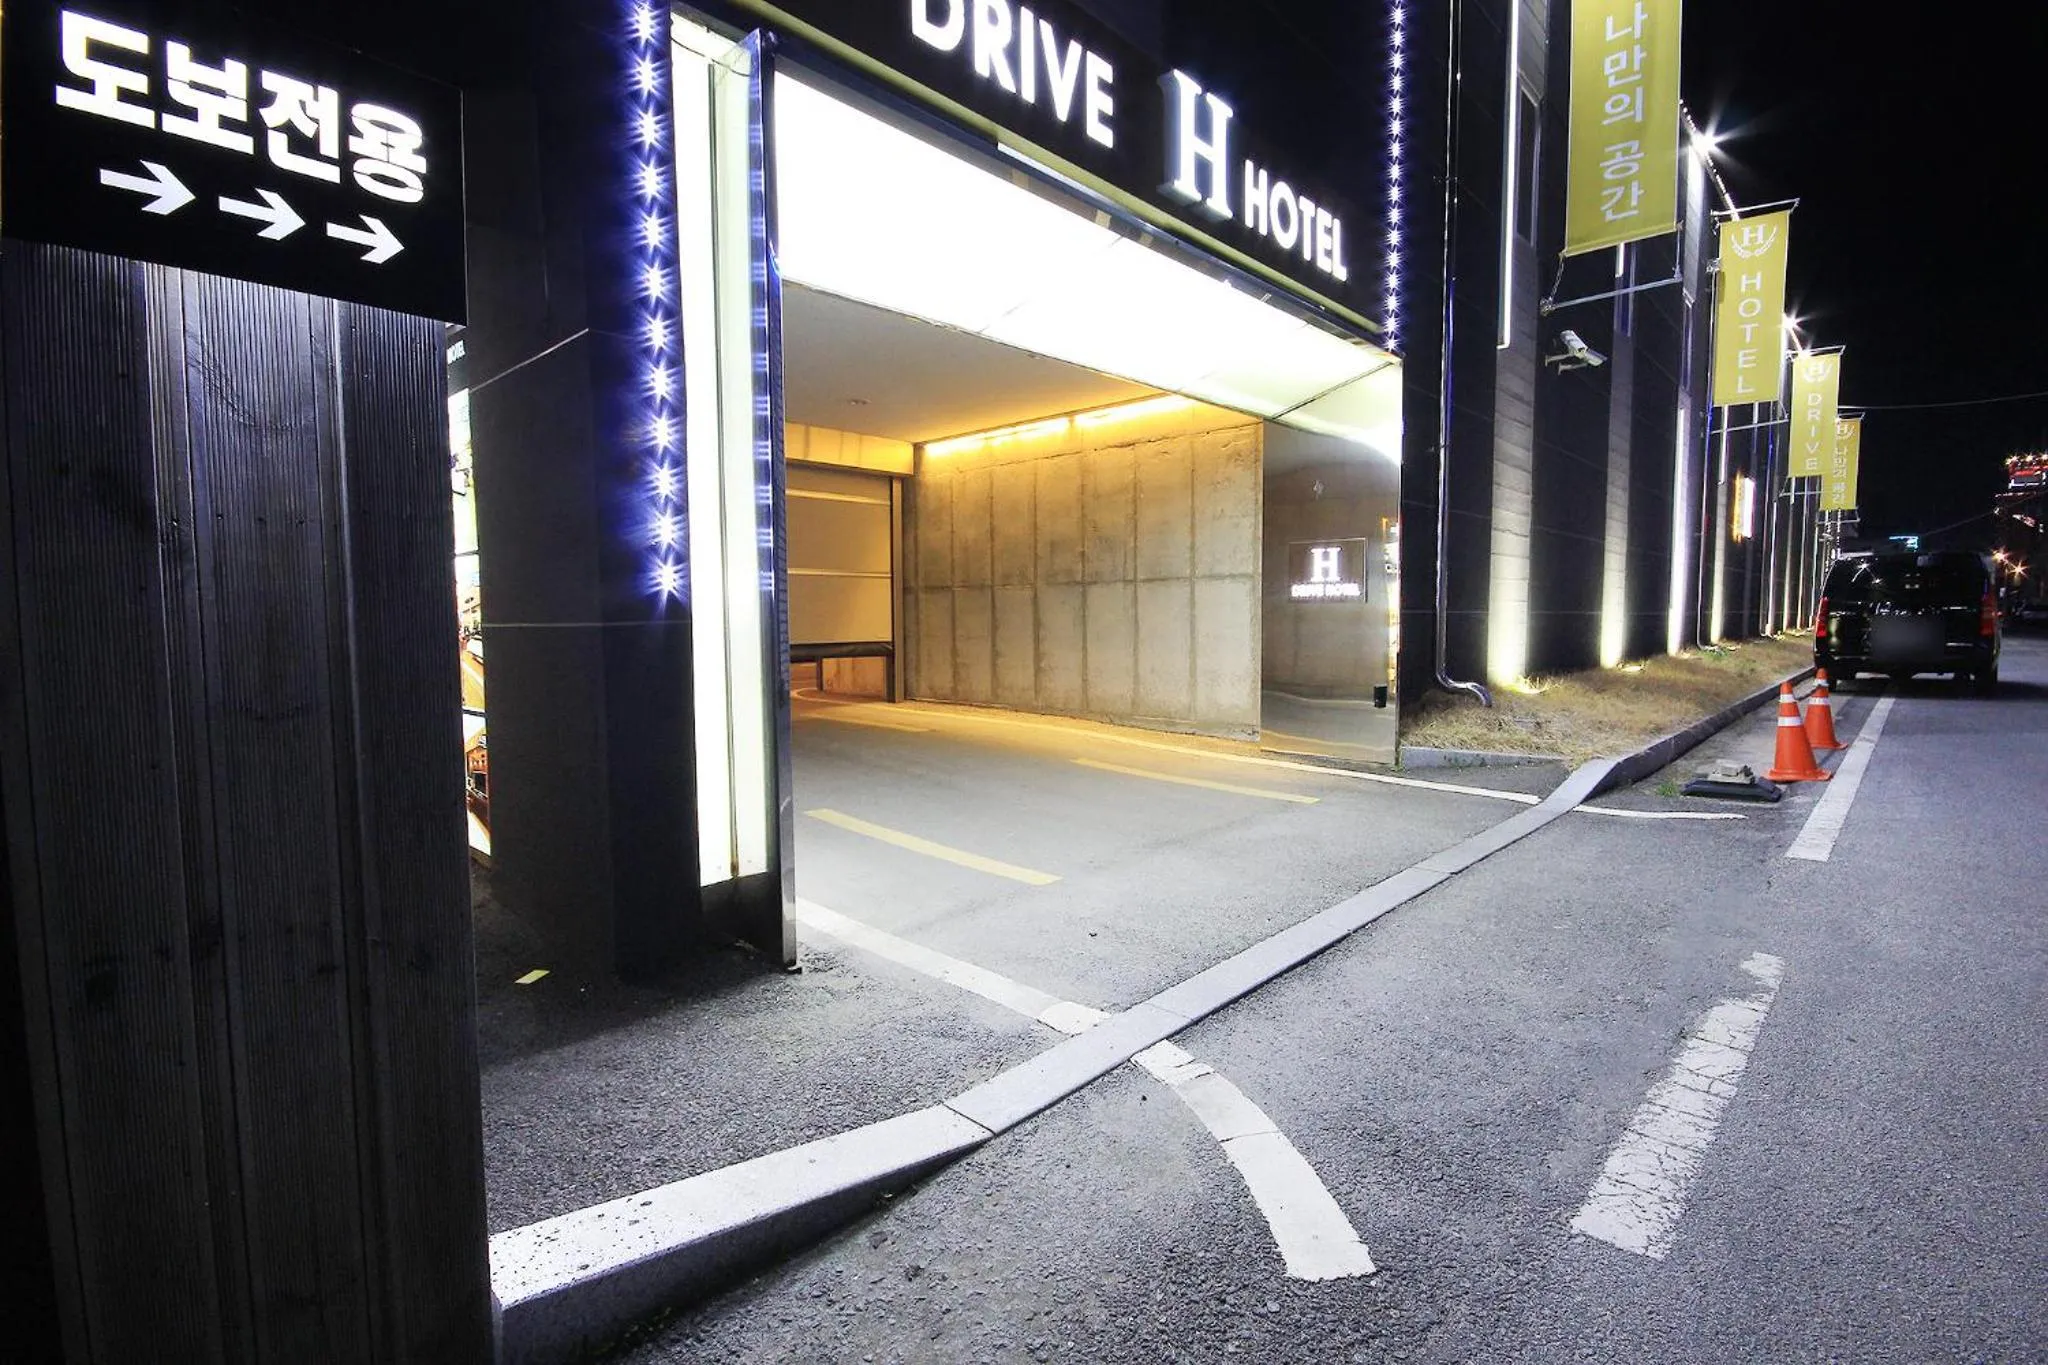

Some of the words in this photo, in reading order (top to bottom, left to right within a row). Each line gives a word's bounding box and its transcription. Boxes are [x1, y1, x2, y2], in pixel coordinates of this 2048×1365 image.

[56, 9, 427, 203] 도보전용
[1602, 0, 1648, 125] 나만의
[1161, 68, 1234, 221] H
[1243, 158, 1348, 282] HOTEL
[1600, 139, 1645, 222] 공간
[1741, 223, 1767, 246] H
[1737, 271, 1762, 394] HOTEL
[1805, 392, 1822, 470] DRIVE
[1310, 546, 1342, 582] H
